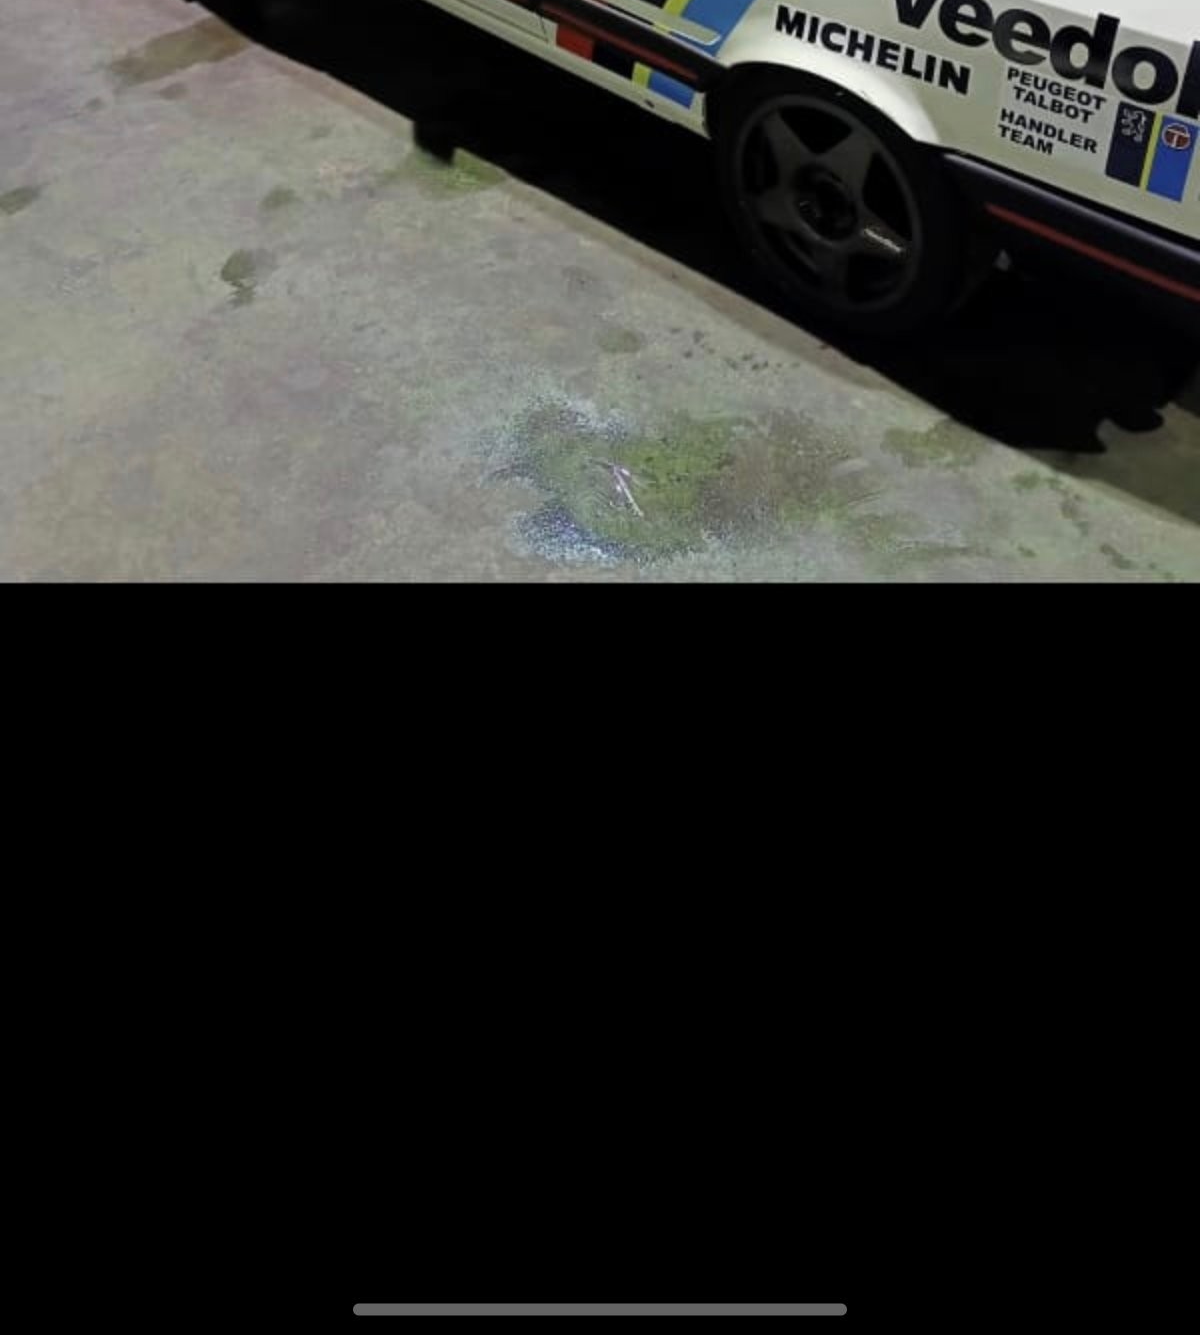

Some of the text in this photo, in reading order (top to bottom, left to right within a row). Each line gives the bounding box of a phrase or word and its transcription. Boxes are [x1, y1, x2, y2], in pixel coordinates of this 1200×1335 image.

[775, 5, 971, 95] MICHELIN
[1007, 66, 1107, 111] PEUGEOT
[1013, 86, 1095, 124] TALBOT
[998, 124, 1054, 155] TEAM
[1000, 108, 1098, 154] HANDLER
